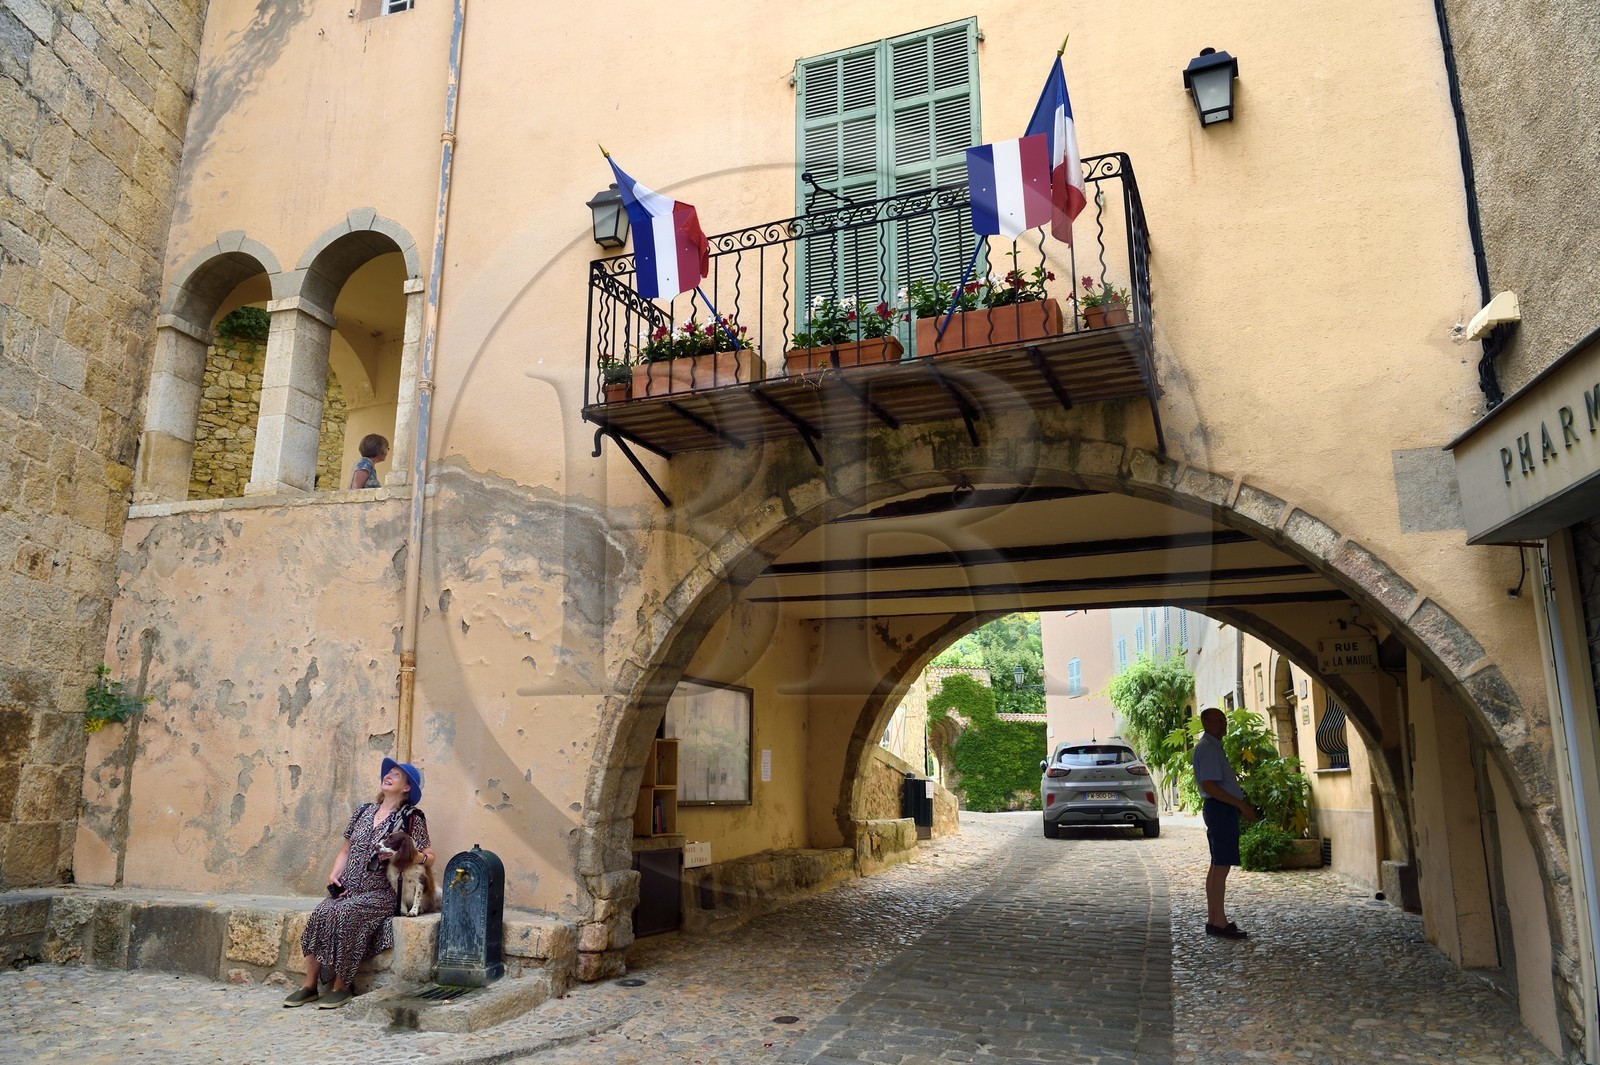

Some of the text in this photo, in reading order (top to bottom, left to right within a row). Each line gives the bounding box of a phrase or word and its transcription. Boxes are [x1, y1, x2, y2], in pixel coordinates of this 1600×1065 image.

[1334, 642, 1359, 652] RUE
[1332, 656, 1343, 667] LA
[1346, 654, 1374, 666] MAIRIE
